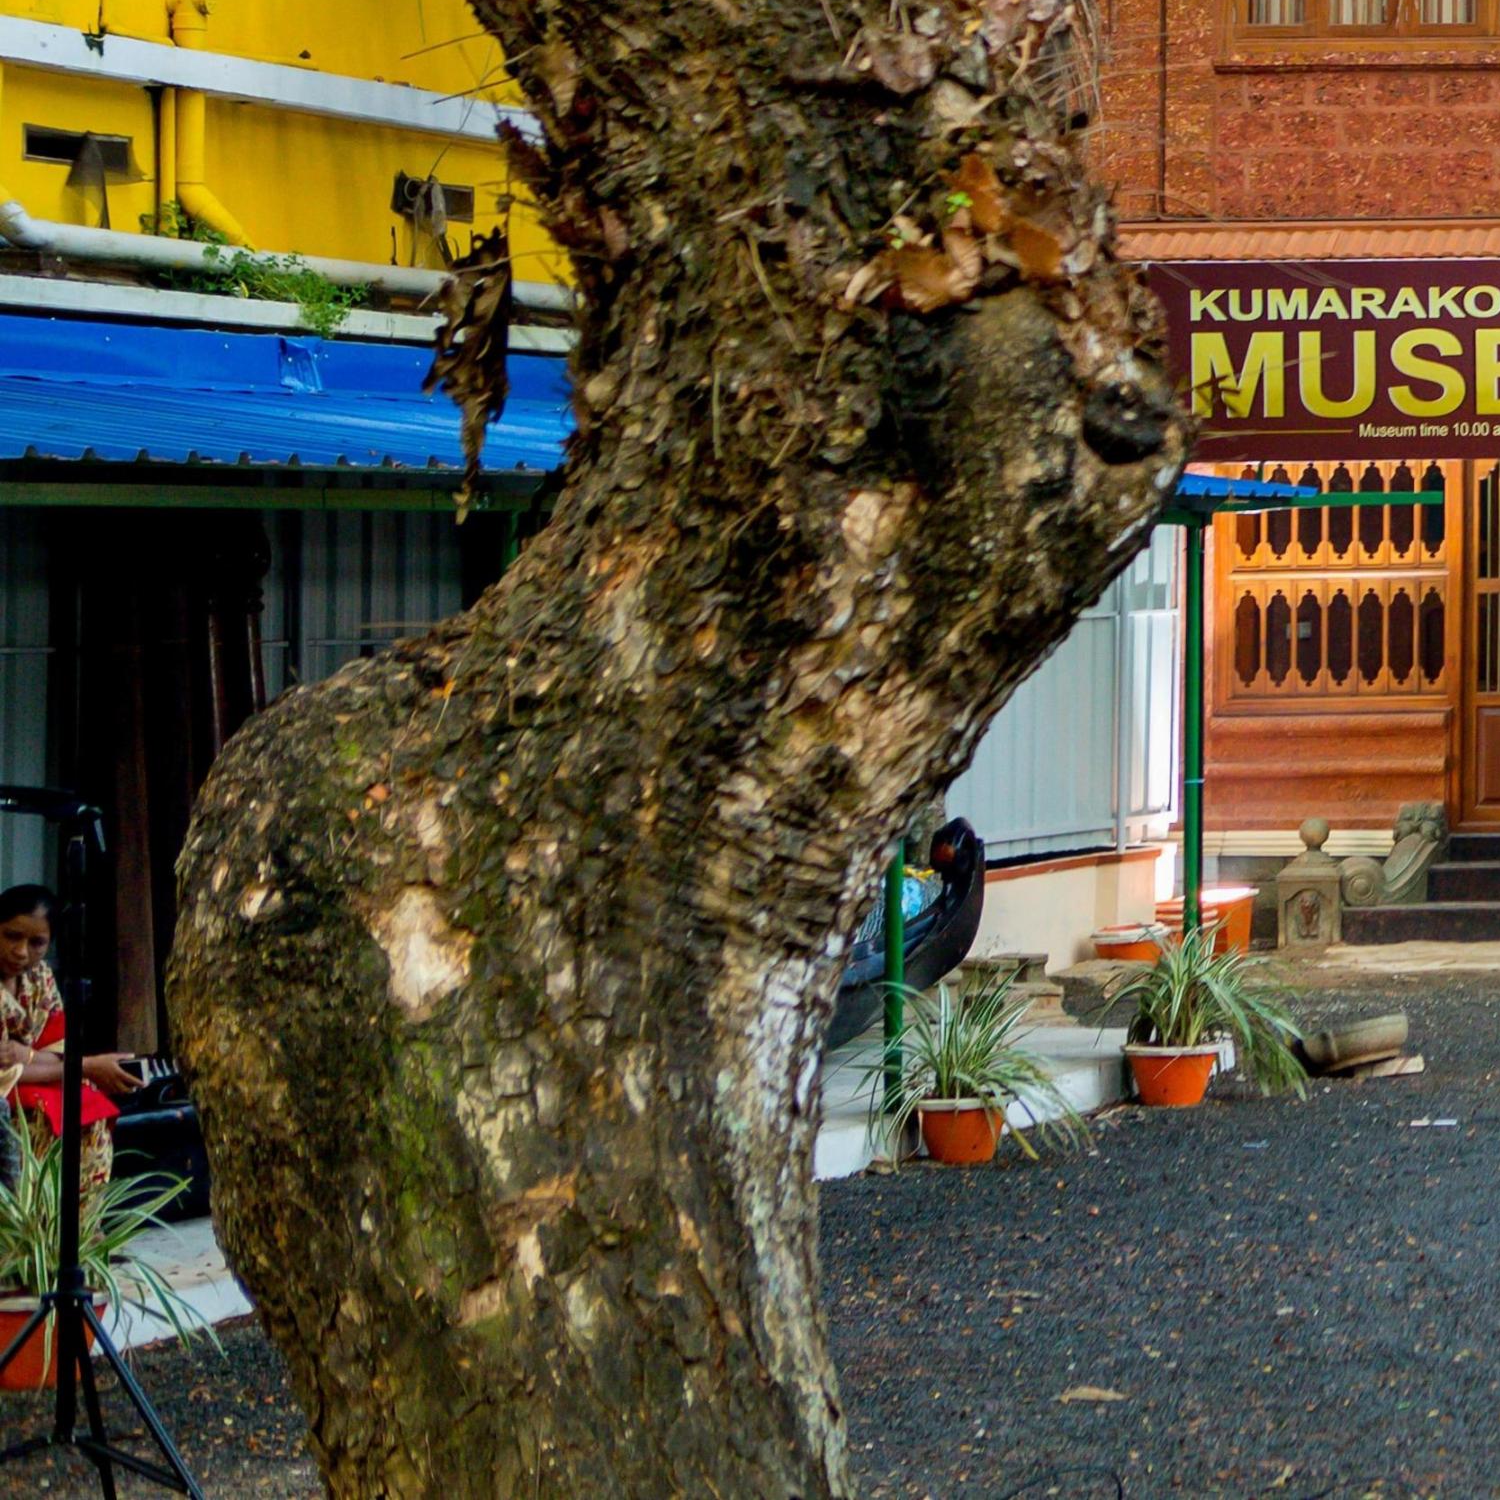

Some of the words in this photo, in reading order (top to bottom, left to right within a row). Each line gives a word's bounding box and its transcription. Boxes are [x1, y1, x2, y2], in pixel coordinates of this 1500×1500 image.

[1358, 422, 1417, 438] Museum
[1420, 422, 1449, 437] time
[1452, 421, 1490, 437] 10.00
